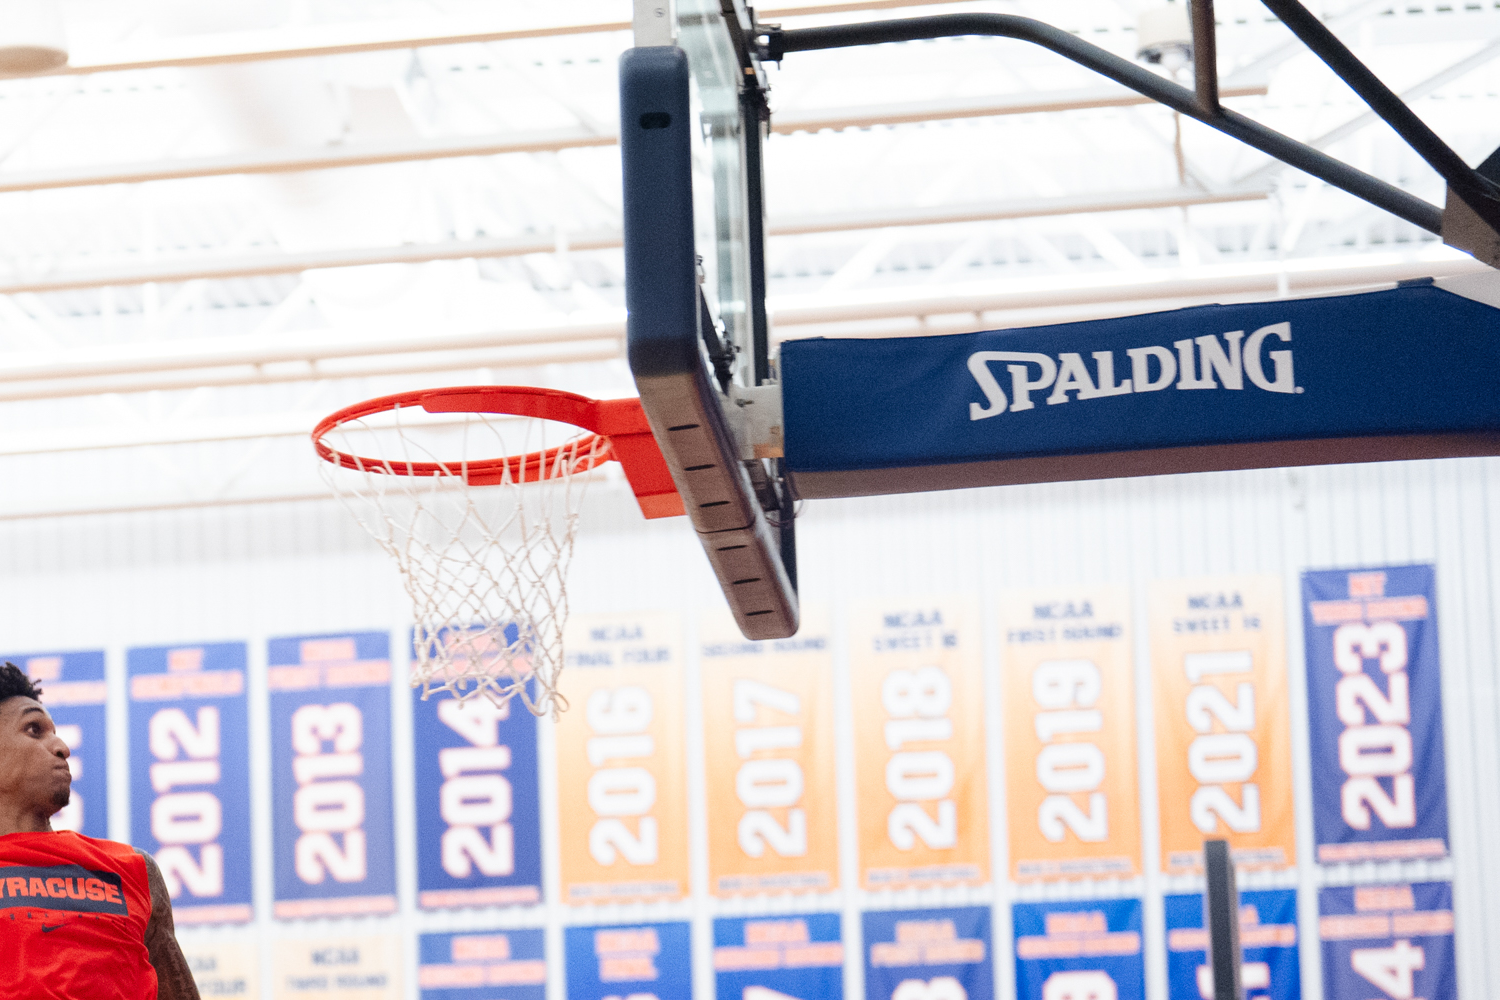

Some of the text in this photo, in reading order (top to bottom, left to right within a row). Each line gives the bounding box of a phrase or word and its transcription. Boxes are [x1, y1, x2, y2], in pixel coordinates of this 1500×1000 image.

[967, 322, 1296, 420] SPALDING
[149, 706, 223, 898] 2012
[292, 702, 366, 884] 2013
[438, 693, 514, 878] 2014
[587, 686, 657, 866] 2016
[734, 678, 807, 858] 2017
[882, 666, 957, 850] 2018
[1032, 659, 1108, 842] 2019
[1184, 650, 1261, 834] 2021
[1333, 622, 1416, 830] 2023
